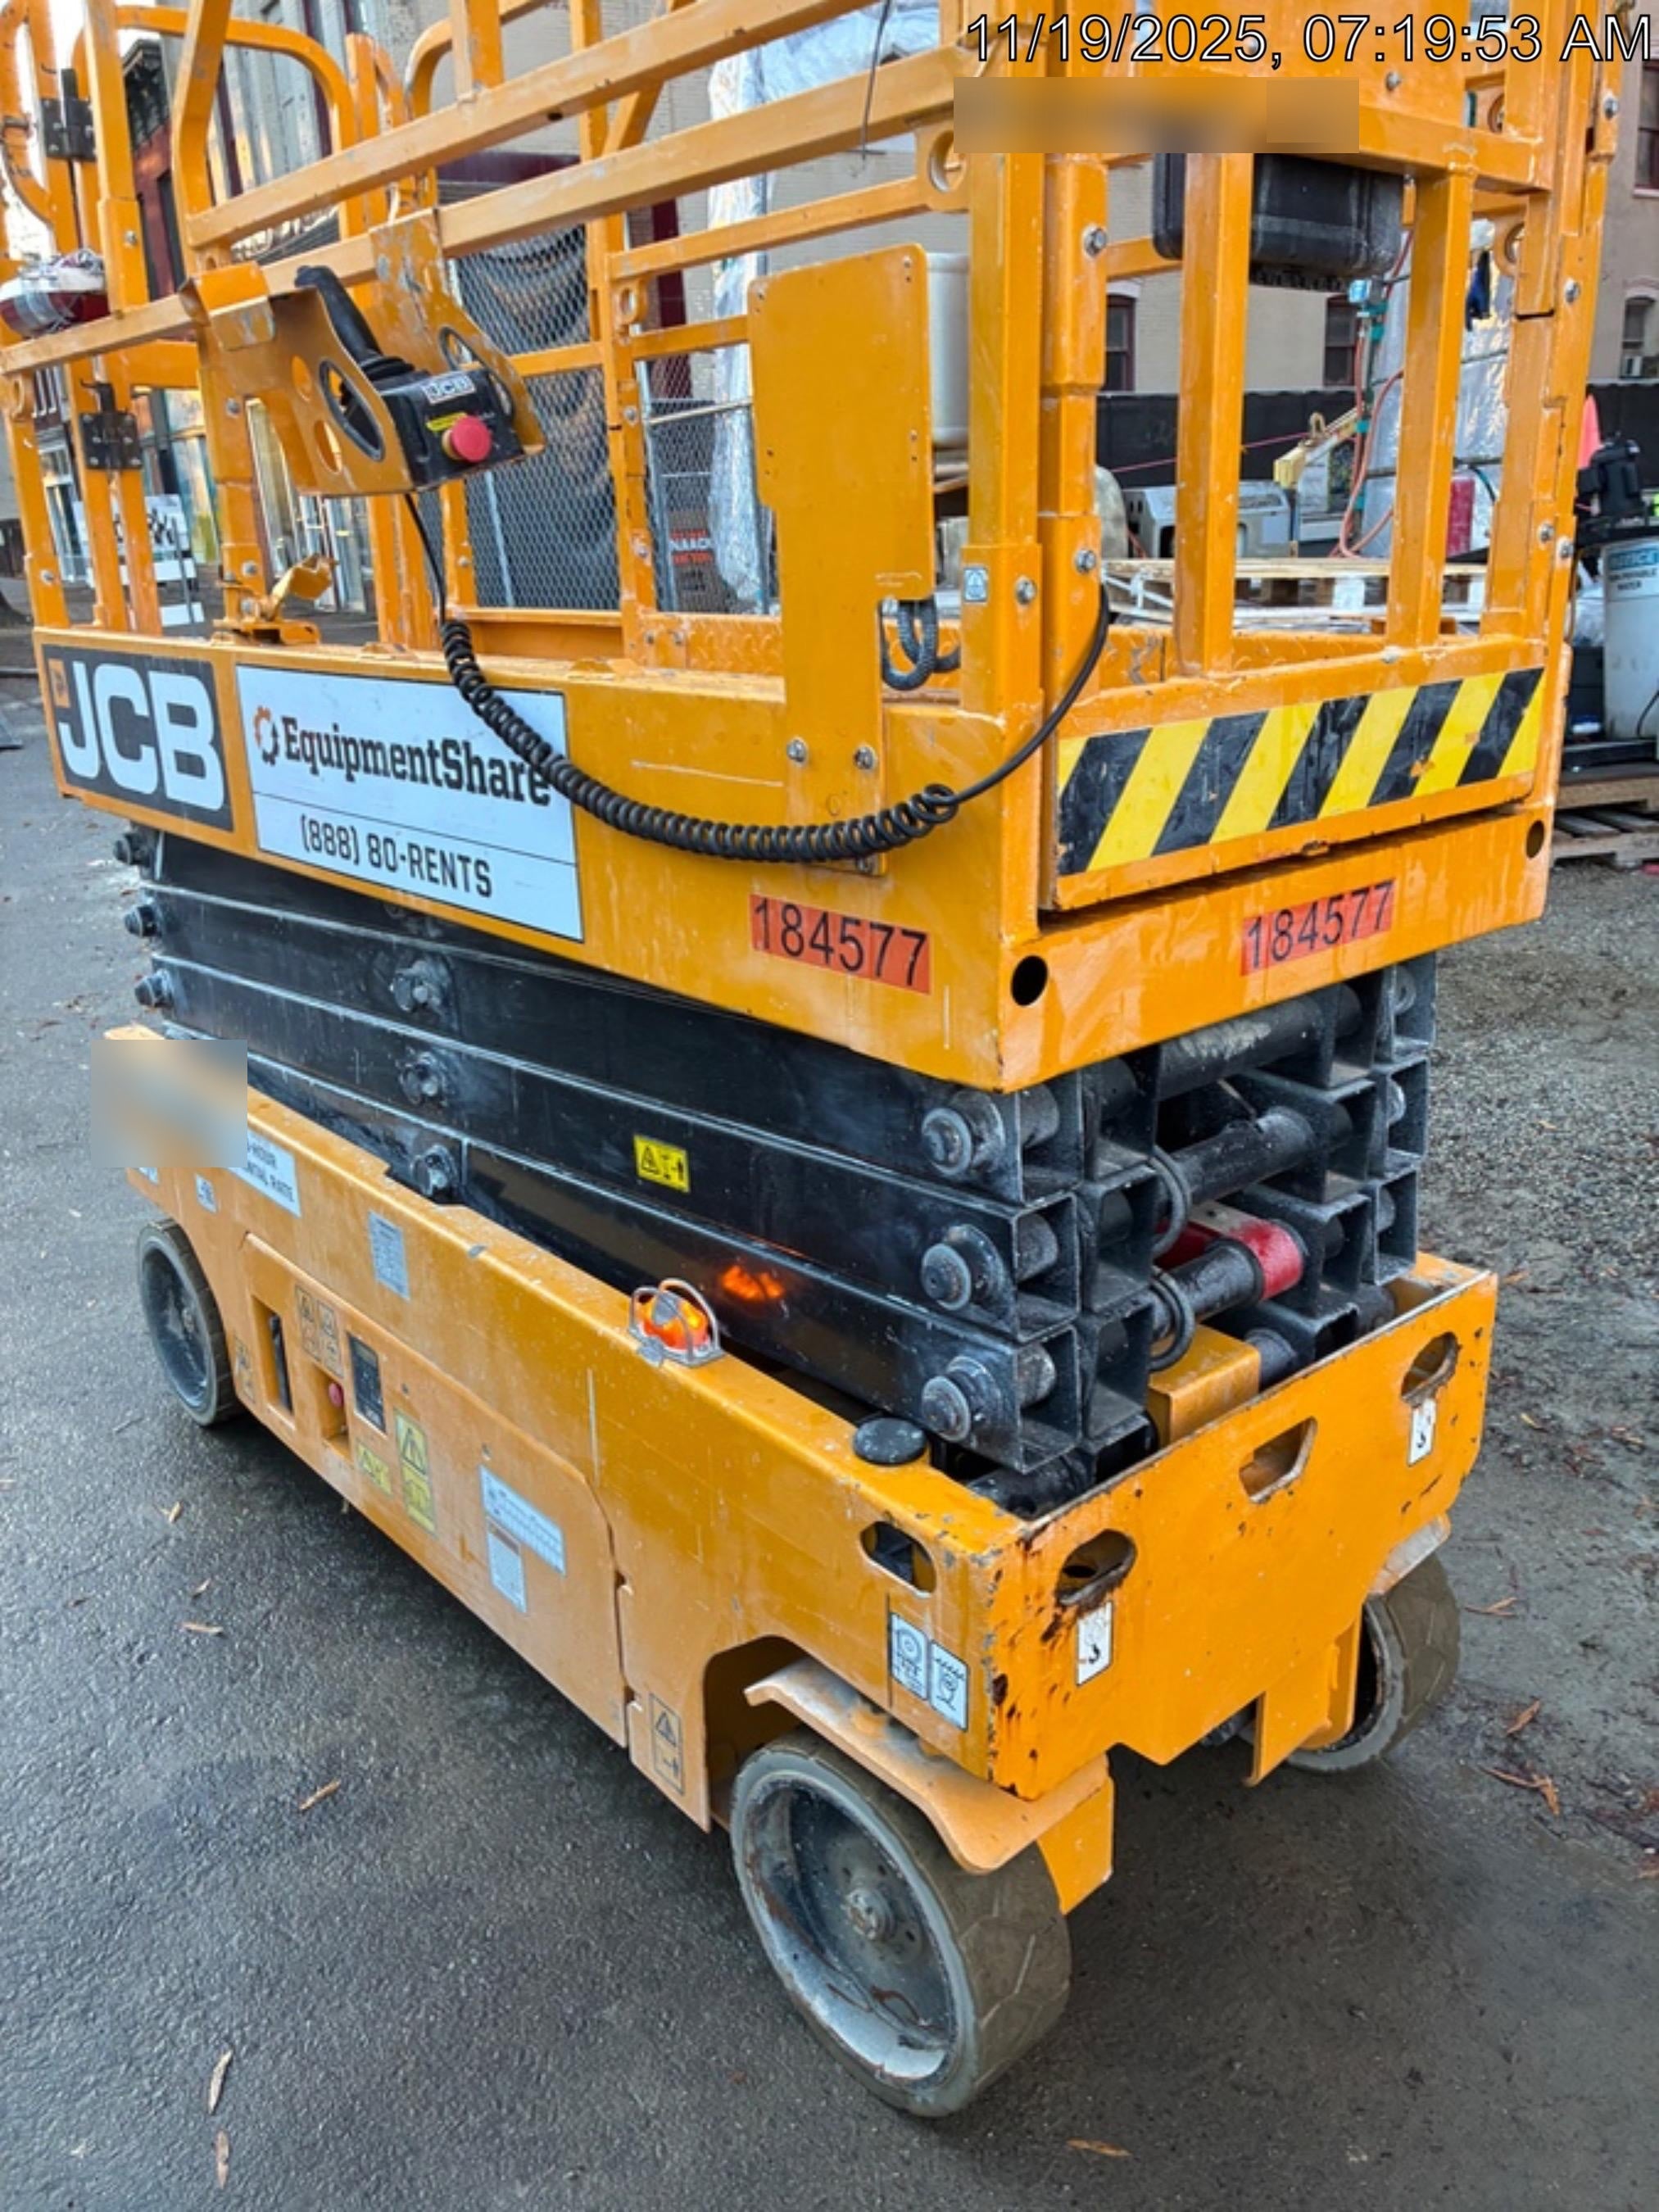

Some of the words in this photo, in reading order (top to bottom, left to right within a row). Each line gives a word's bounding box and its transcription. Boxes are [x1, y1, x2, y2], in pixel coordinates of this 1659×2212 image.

[58, 660, 224, 811] JCB
[282, 715, 551, 806] EquipmentShare
[301, 814, 360, 866] (888)
[367, 832, 492, 898] 80-RENTS
[755, 897, 928, 986] 184577
[1249, 878, 1395, 968] 184577
